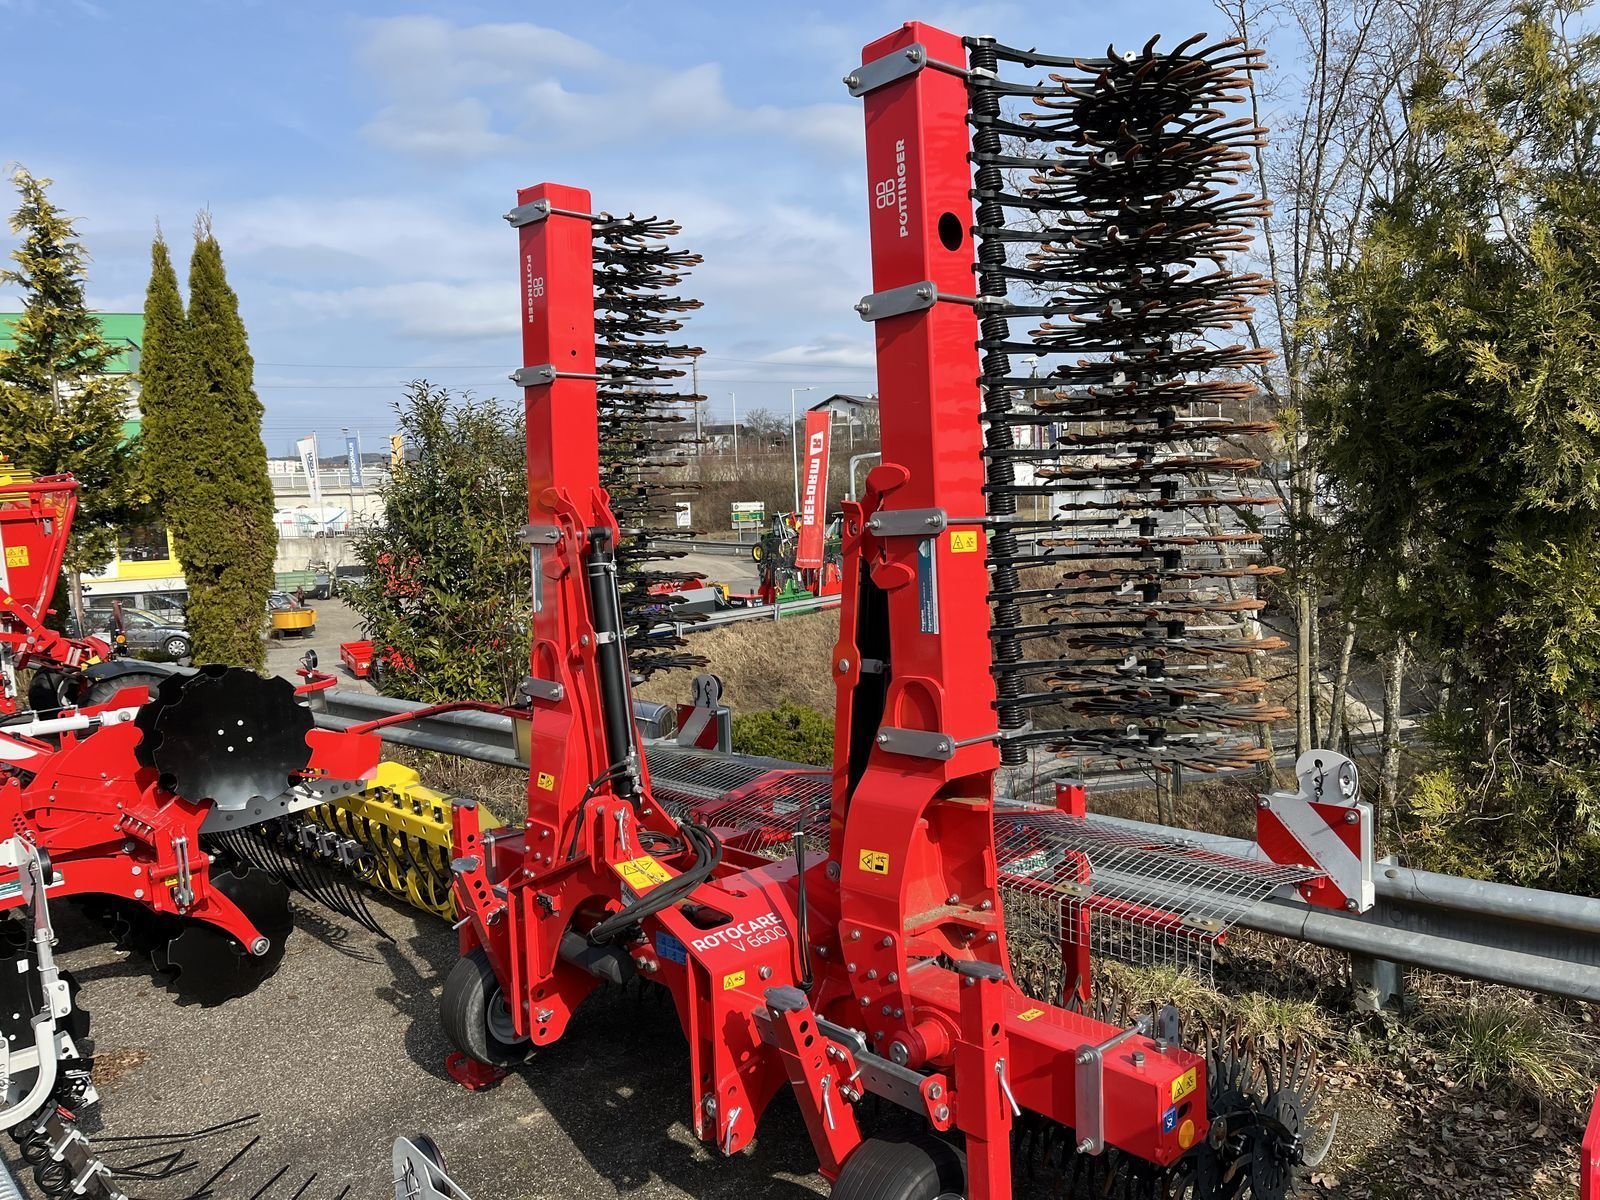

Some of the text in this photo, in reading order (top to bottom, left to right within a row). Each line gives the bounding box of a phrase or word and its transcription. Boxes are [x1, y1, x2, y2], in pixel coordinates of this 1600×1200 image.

[691, 912, 782, 952] ROTOCARE
[730, 925, 787, 952] V 6600
